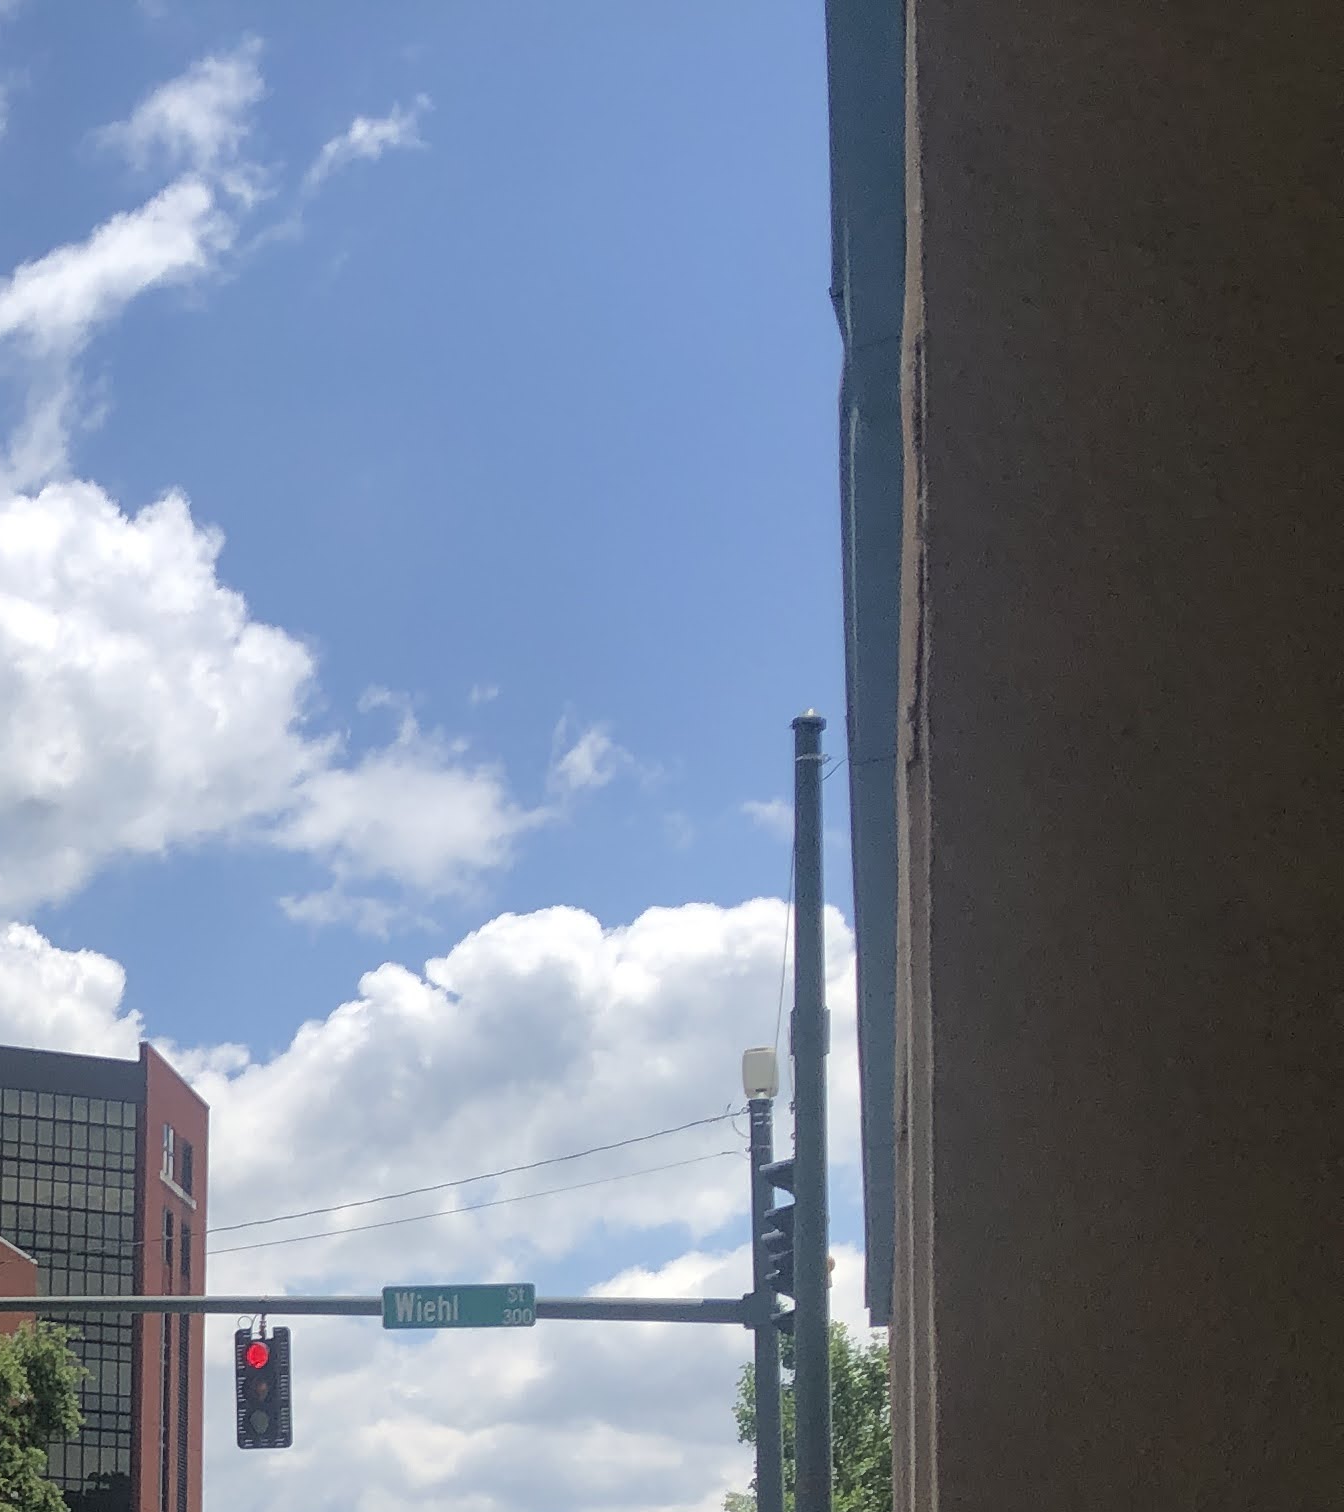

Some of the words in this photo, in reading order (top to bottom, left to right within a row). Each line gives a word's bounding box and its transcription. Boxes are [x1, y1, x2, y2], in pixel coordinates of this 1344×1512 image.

[394, 1291, 459, 1323] Wiehl
[507, 1286, 525, 1303] St
[502, 1308, 533, 1326] 300
